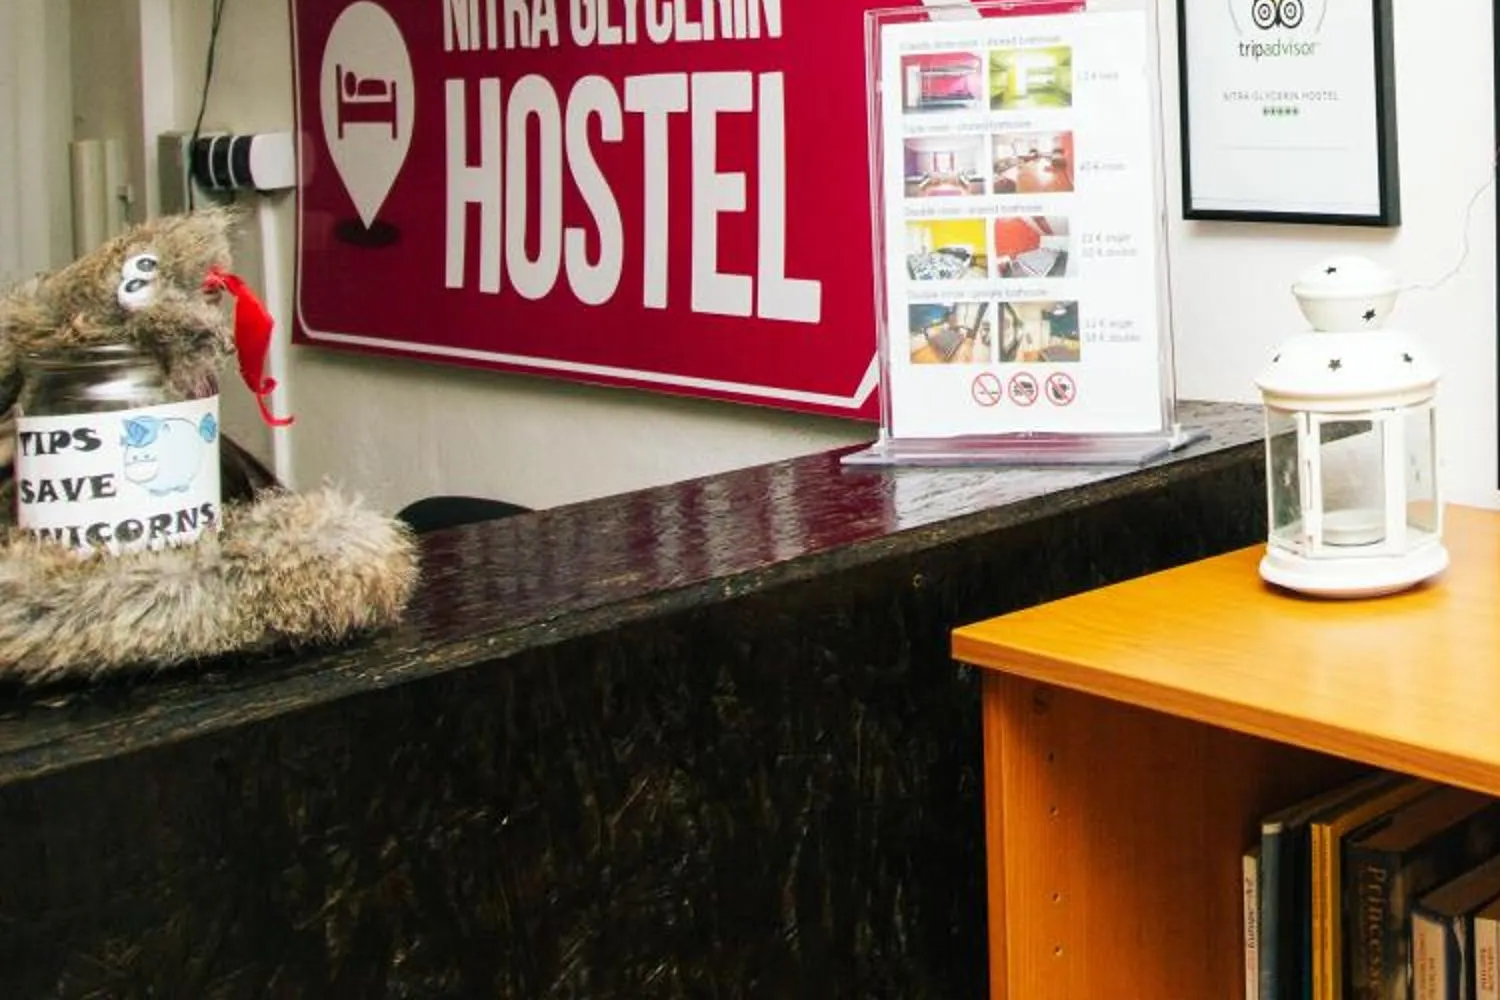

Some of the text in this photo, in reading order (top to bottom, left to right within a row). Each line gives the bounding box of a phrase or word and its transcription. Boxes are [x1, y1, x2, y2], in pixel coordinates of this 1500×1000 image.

[1238, 39, 1317, 62] tripadvisor
[445, 71, 822, 324] HOSTEL
[19, 426, 103, 457] TIPS
[20, 473, 118, 504] SAVE
[29, 503, 216, 549] NICORNS
